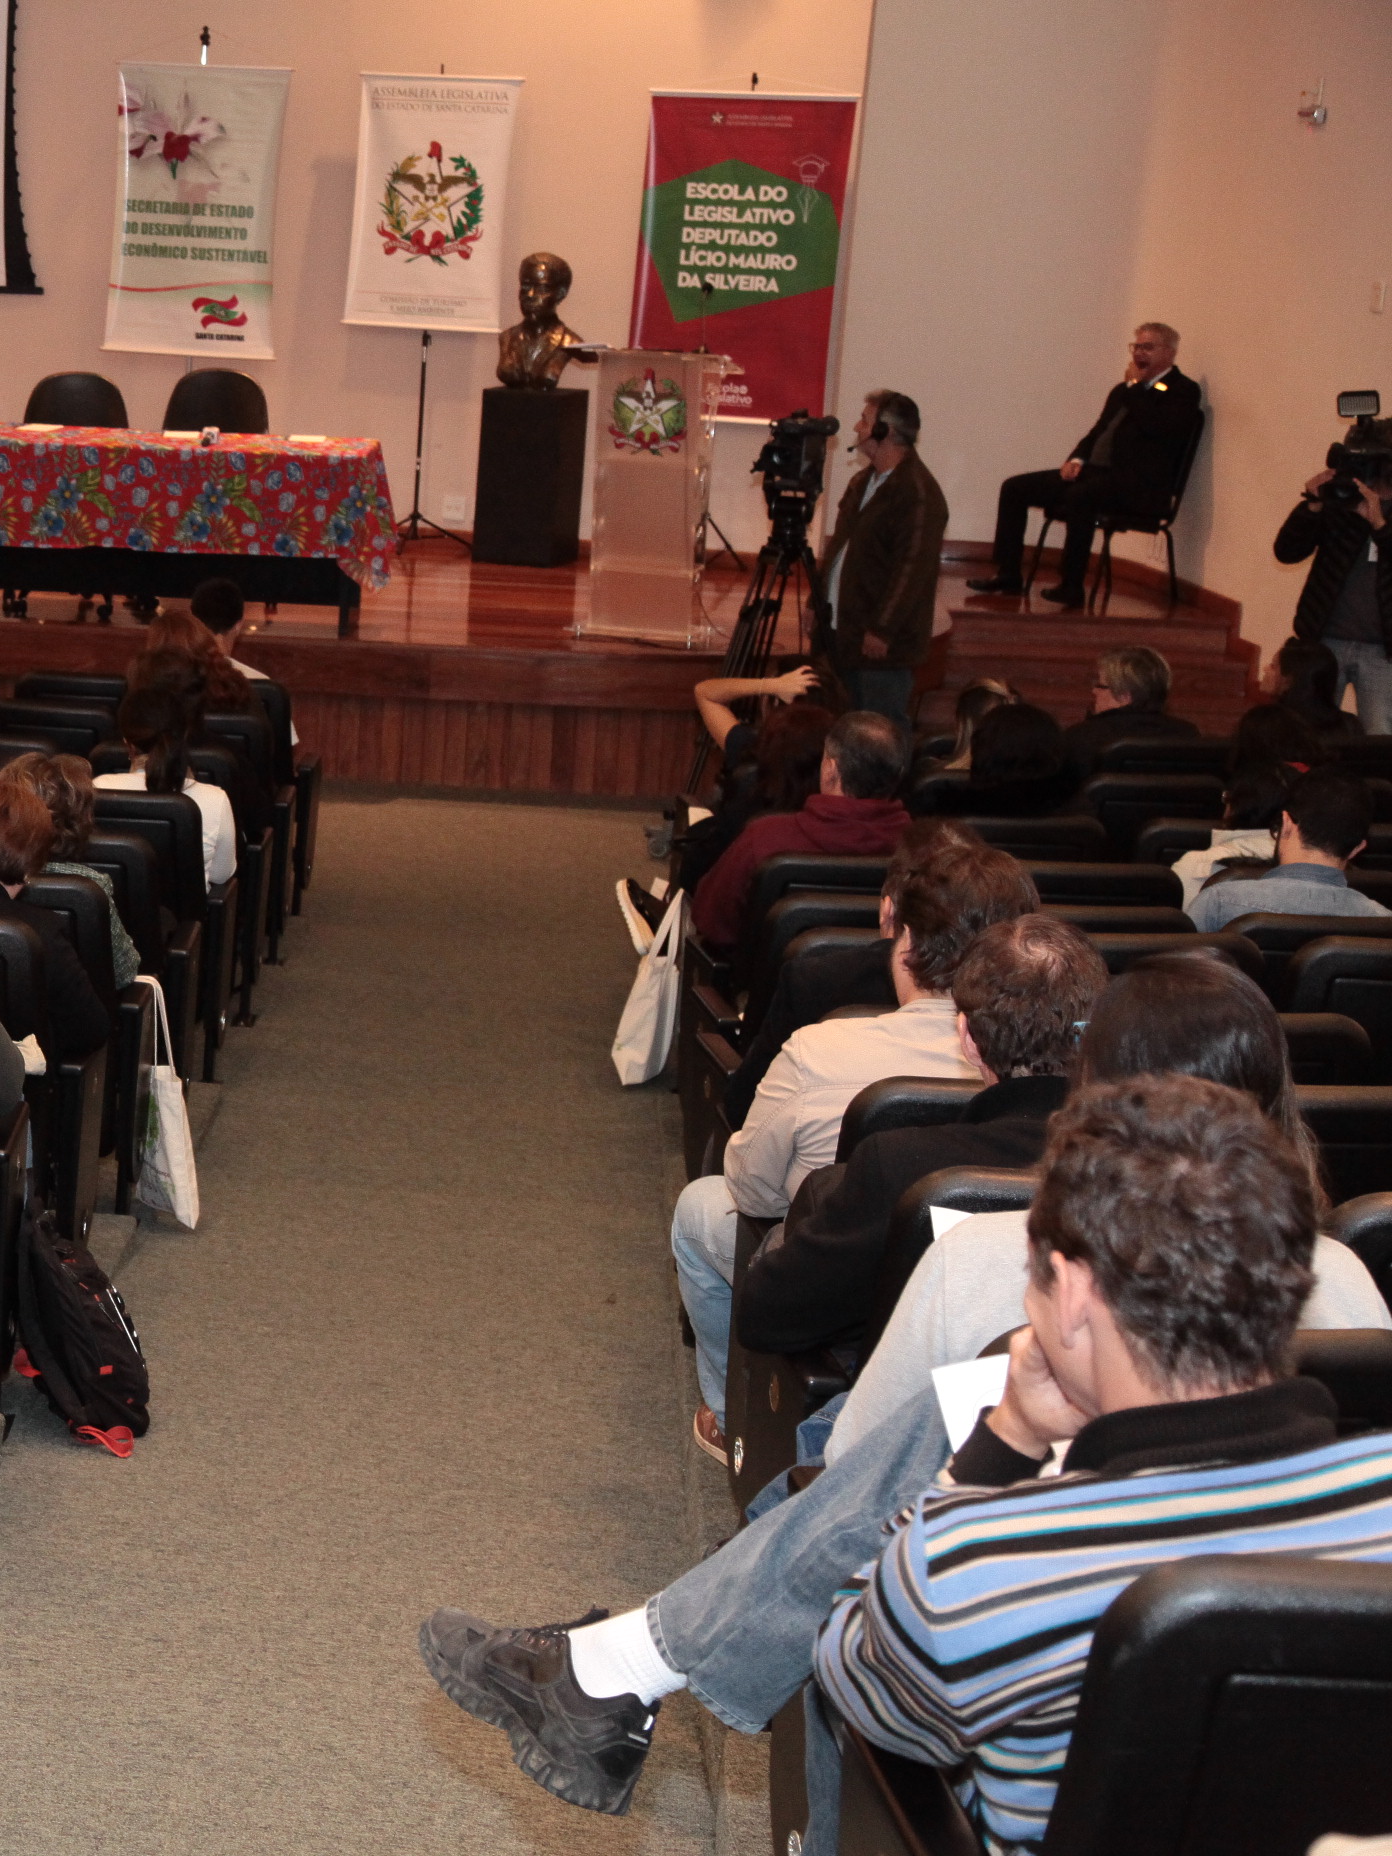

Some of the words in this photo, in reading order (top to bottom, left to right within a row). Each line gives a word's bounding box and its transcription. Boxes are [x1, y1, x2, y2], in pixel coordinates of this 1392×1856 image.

[441, 89, 508, 100] LEGISLATIVA
[686, 182, 756, 201] ESCOLA
[759, 185, 788, 202] DO
[127, 199, 190, 215] SECRETARIA
[192, 202, 207, 216] DE
[210, 203, 254, 219] ESTADO
[684, 205, 796, 225] LEGISLATIVO
[124, 221, 138, 234] DO
[141, 222, 248, 240] DESENVOLVIMENTO
[681, 227, 778, 247] DEPUTADO
[122, 242, 188, 259] ECONÔMICO
[679, 245, 727, 267] LÍCIO
[728, 252, 797, 271] MAURO
[677, 271, 702, 288] DA
[704, 272, 780, 293] SILVEIRA
[195, 332, 214, 340] SANTA
[215, 333, 245, 342] CATARINA
